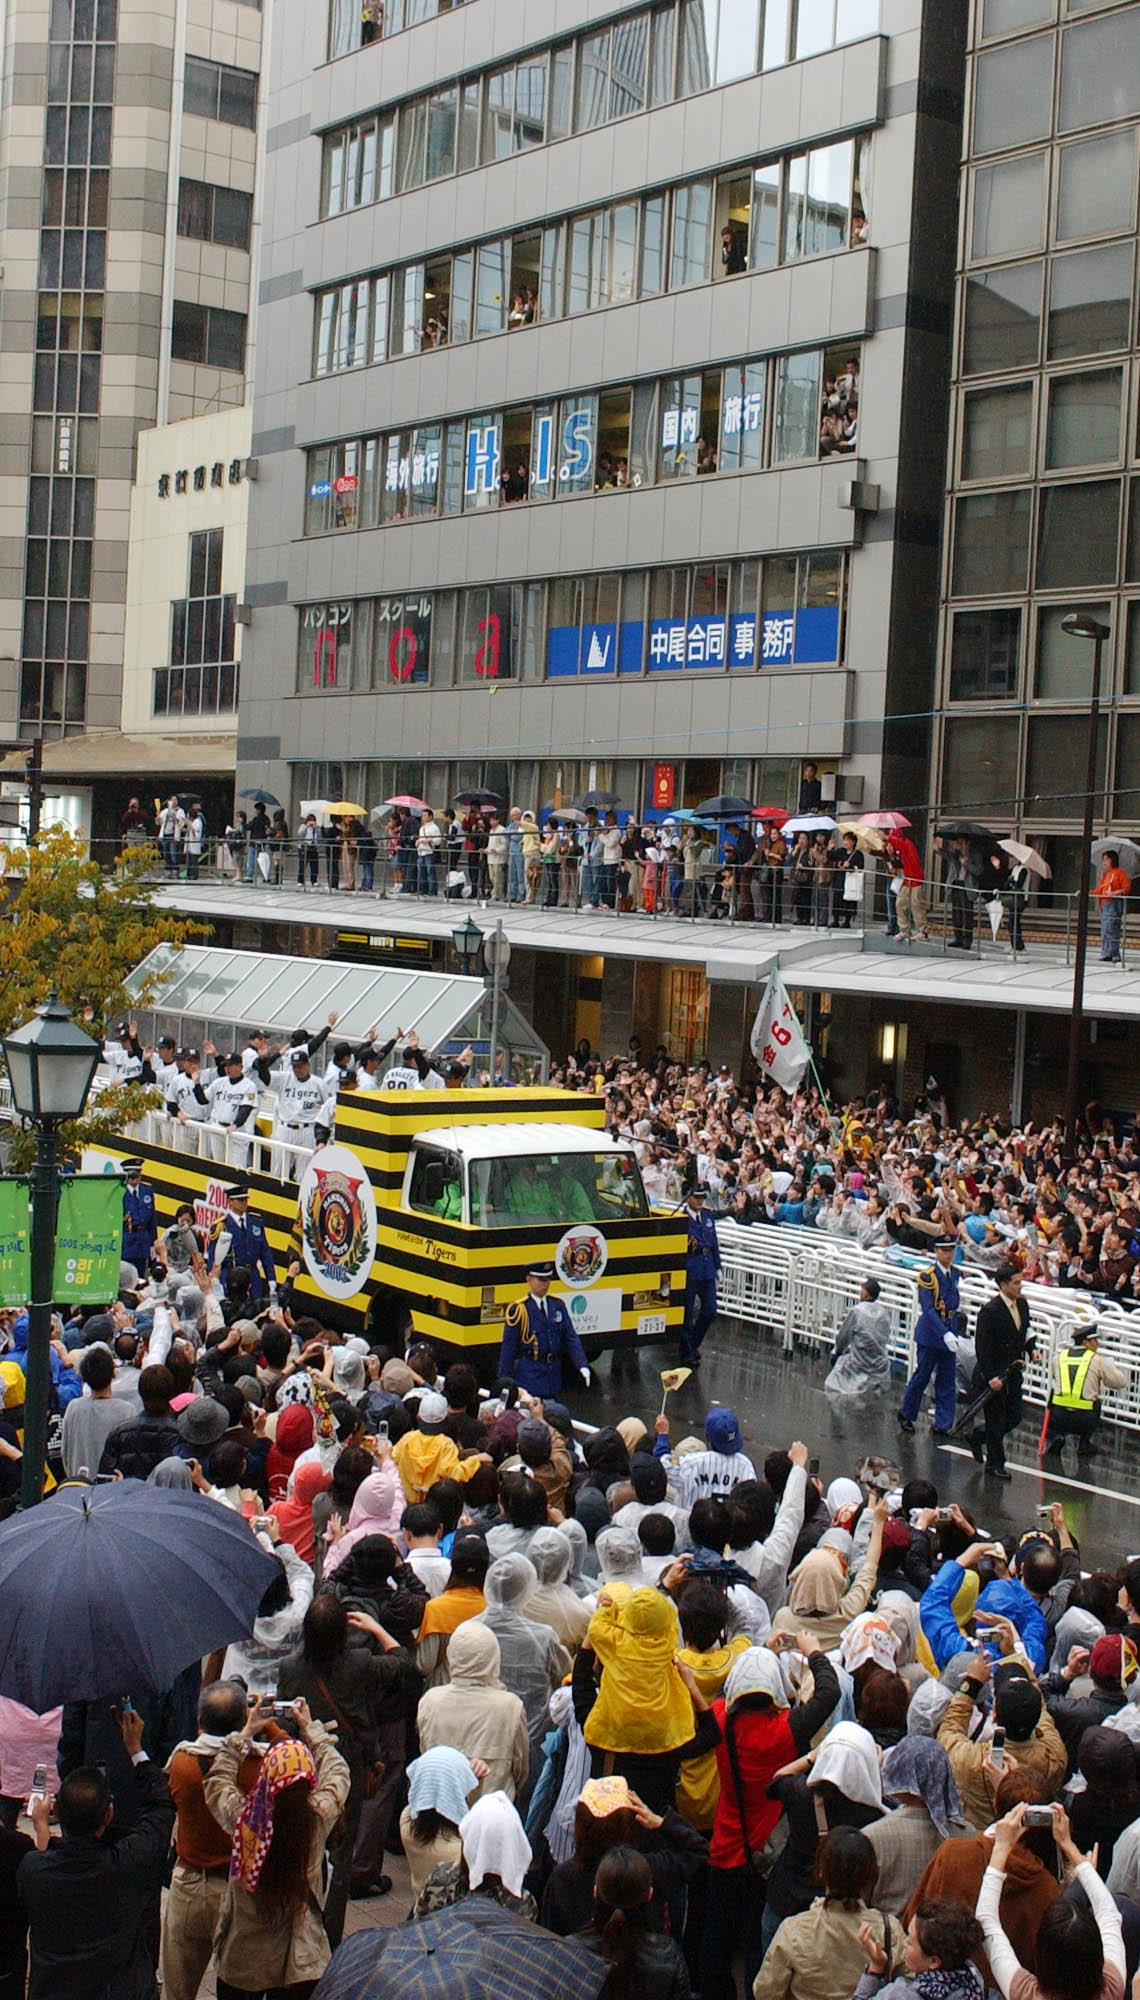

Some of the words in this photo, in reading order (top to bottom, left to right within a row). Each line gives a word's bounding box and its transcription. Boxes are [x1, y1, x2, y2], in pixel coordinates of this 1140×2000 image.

[284, 1087, 319, 1101] Tigers
[323, 1234, 350, 1257] Tigers
[425, 1239, 457, 1262] Tigers
